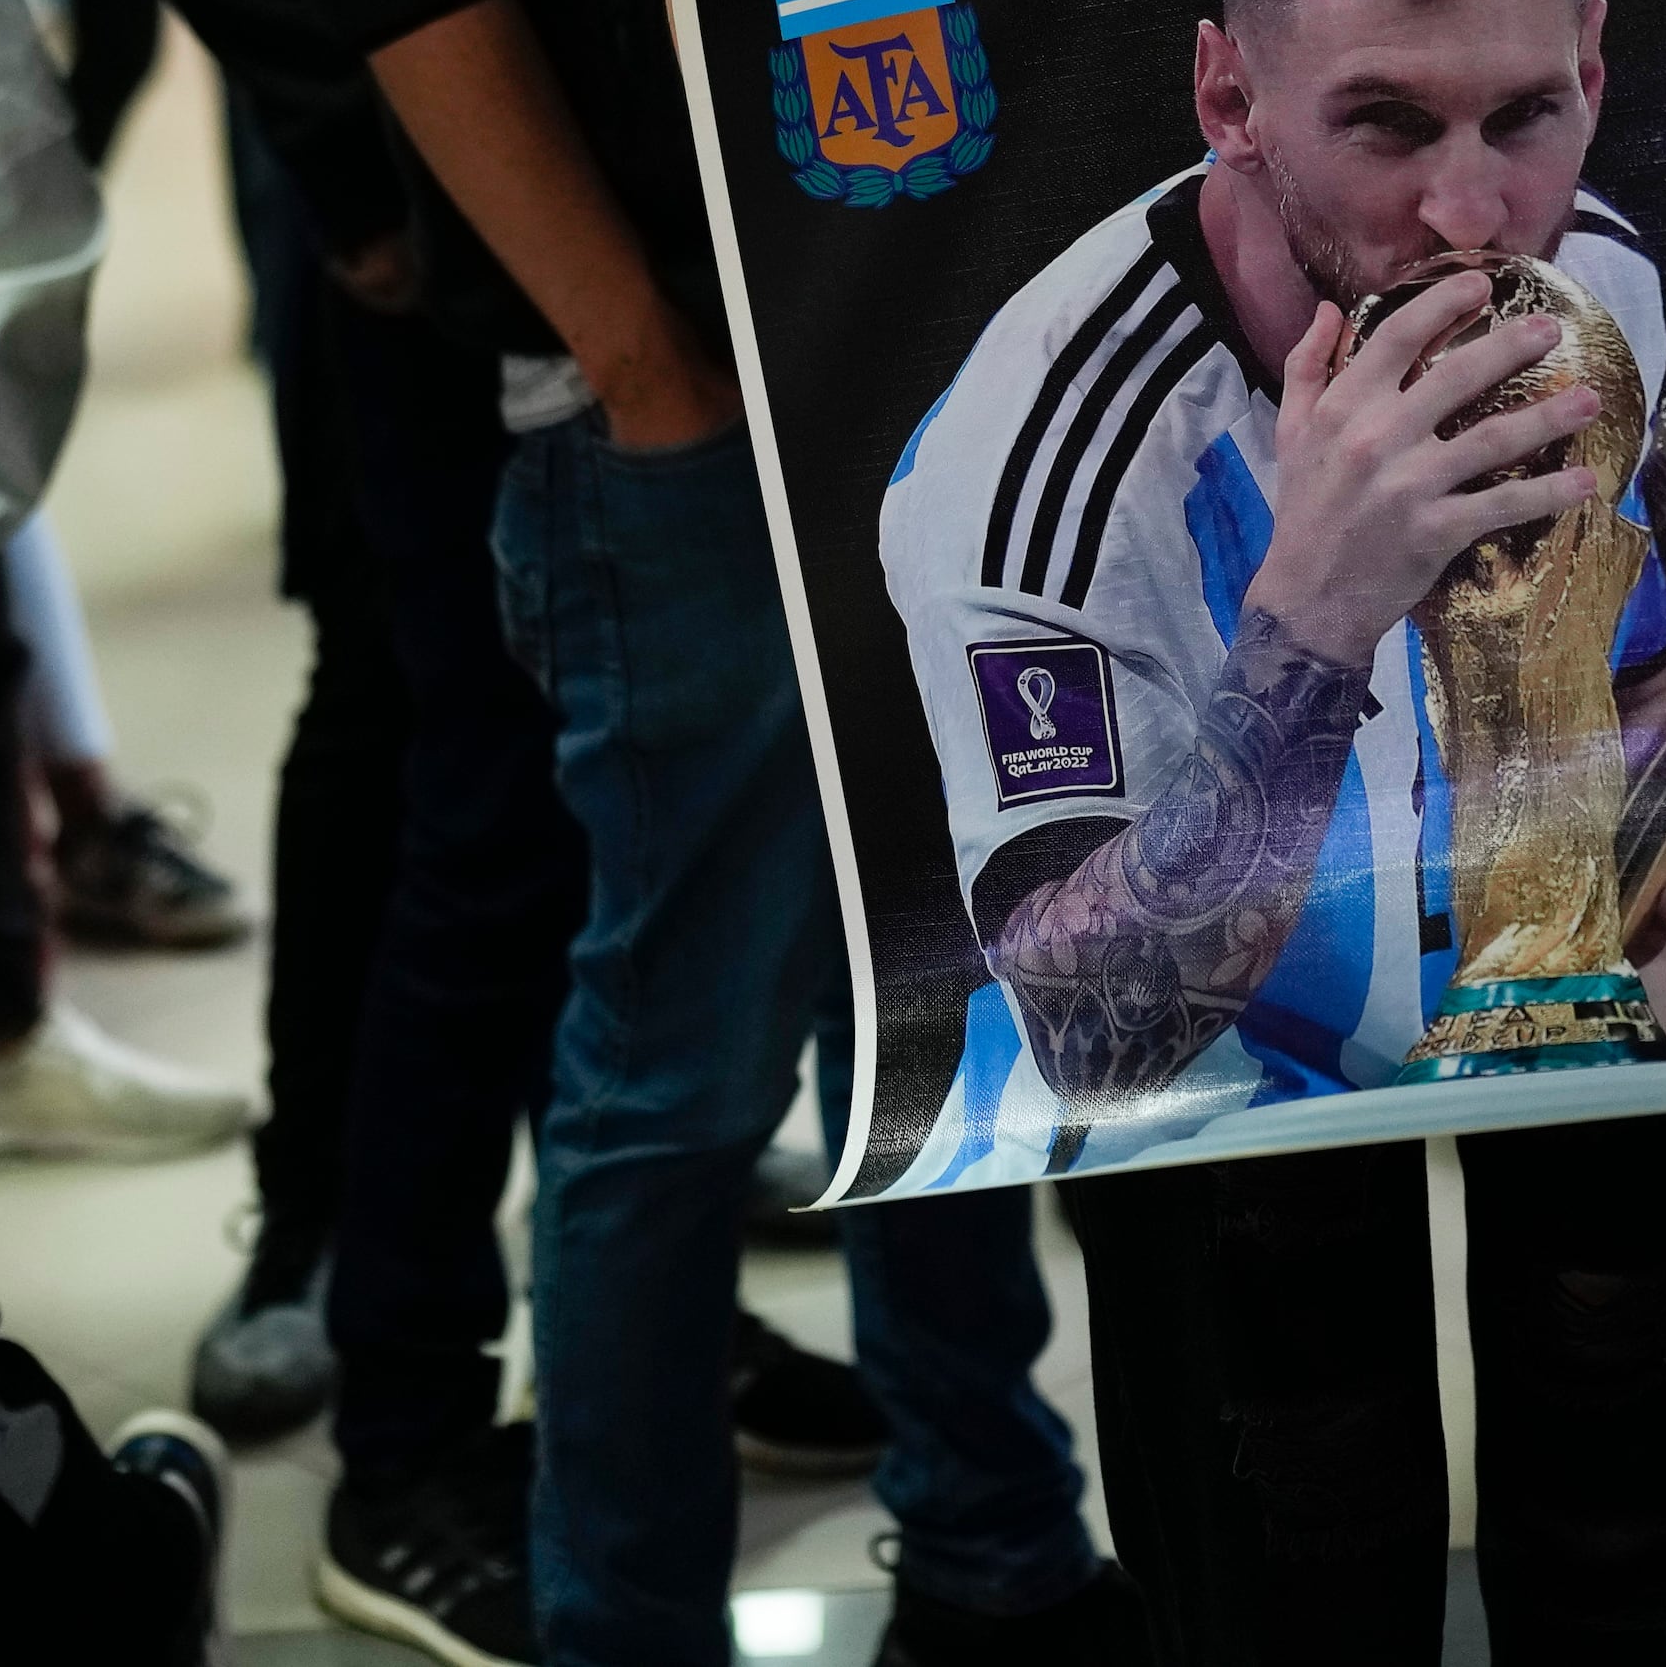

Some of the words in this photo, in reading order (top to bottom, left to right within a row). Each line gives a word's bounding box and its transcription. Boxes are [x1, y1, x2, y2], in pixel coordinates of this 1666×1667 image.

[819, 32, 949, 148] AFA
[1001, 751, 1027, 766] FIFA
[1027, 746, 1069, 761] WORLD
[1069, 746, 1094, 756] CUP
